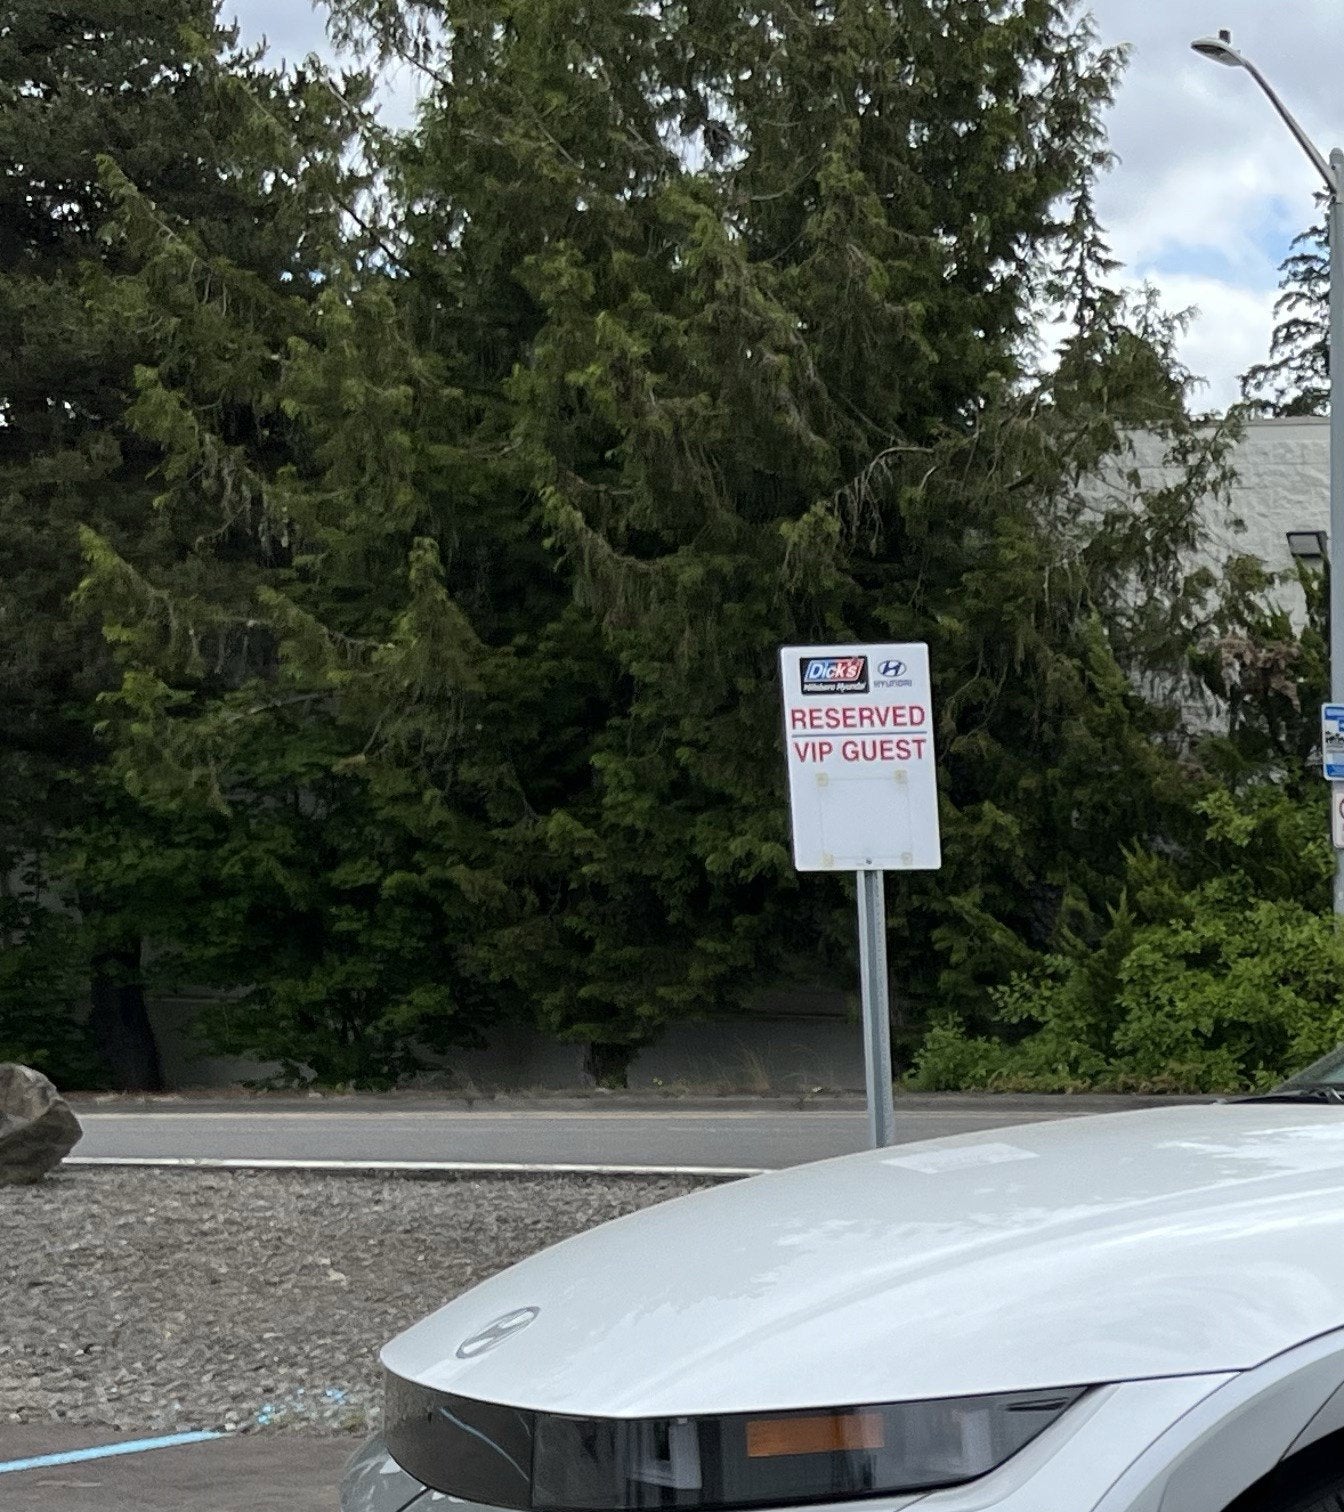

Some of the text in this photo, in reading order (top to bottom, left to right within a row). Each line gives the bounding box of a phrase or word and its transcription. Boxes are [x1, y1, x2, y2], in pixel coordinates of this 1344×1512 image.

[791, 704, 925, 729] RESERVED
[795, 738, 926, 762] VIP GUEST
